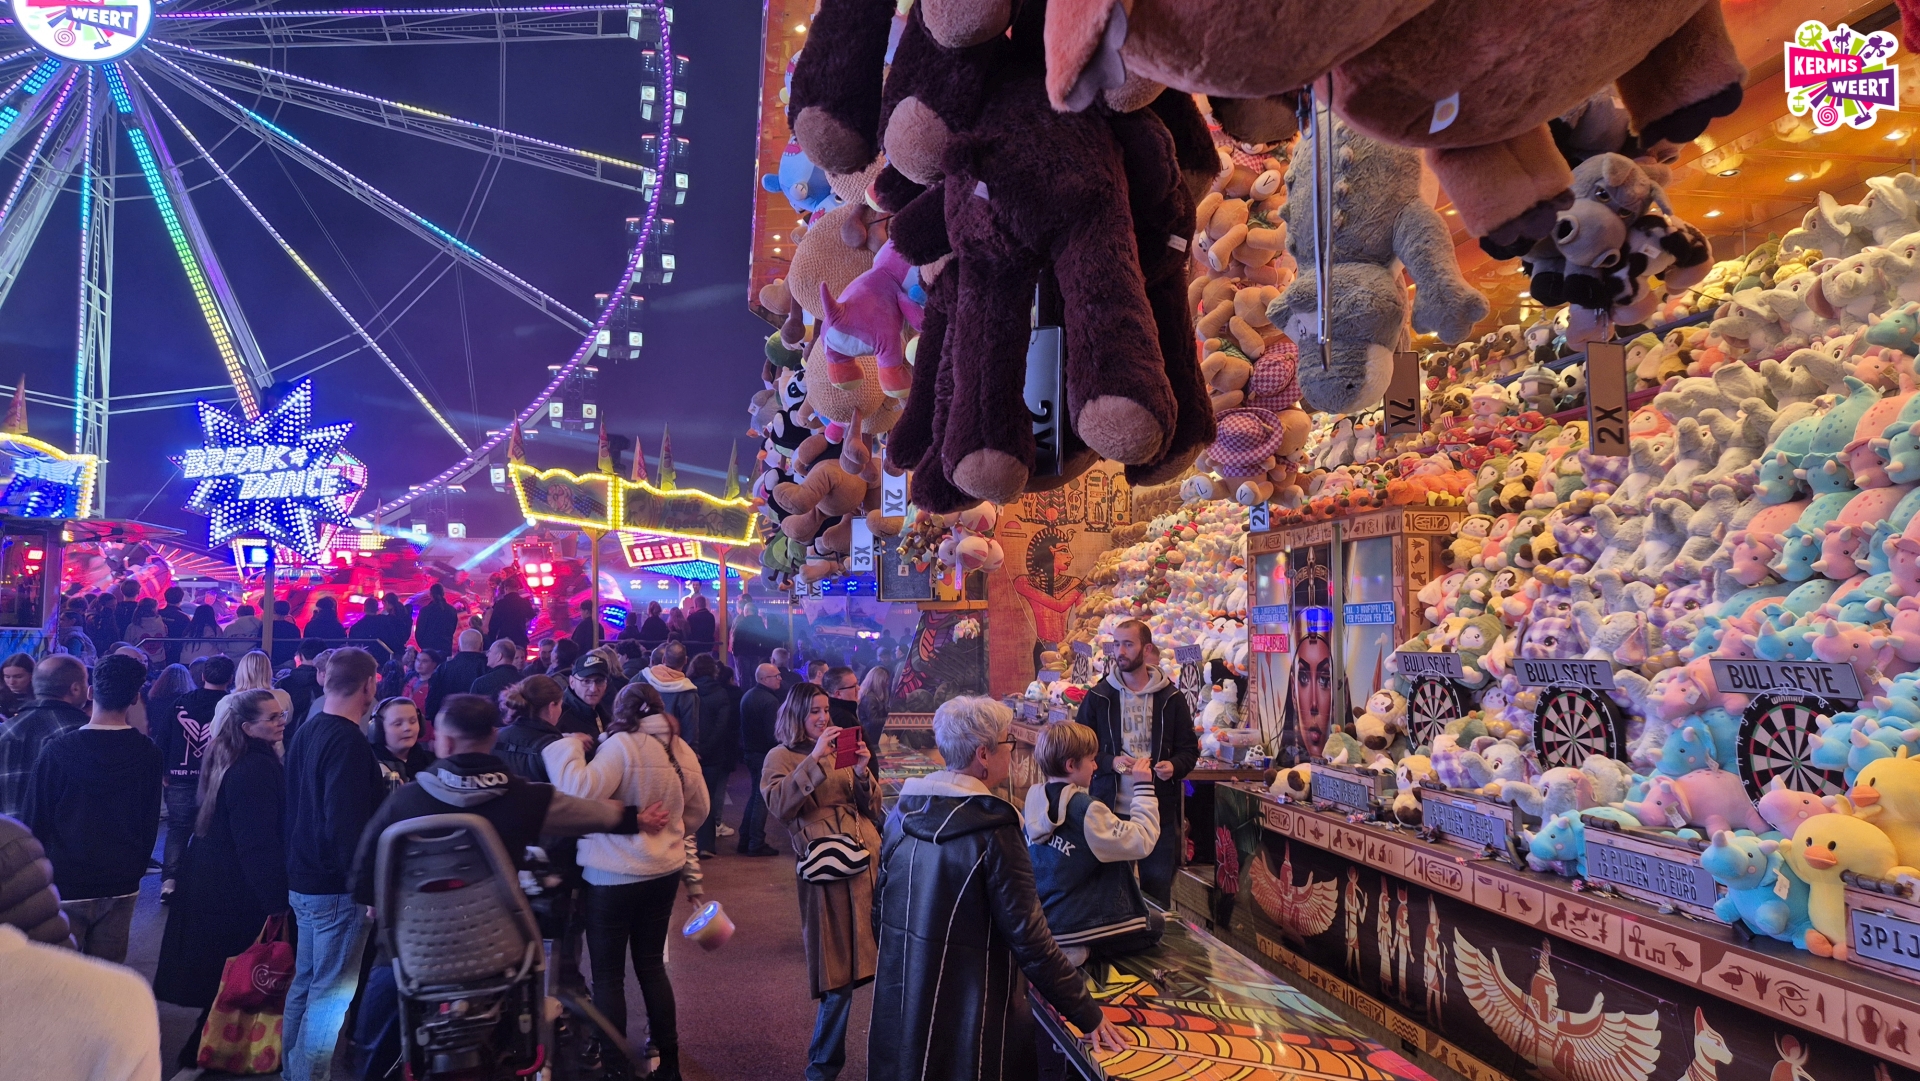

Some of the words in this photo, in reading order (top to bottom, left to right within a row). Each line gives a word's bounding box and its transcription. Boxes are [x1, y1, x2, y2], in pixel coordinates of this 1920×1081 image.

[71, 7, 133, 29] WEERT
[1595, 406, 1625, 445] 2X
[184, 445, 291, 478] BREAK
[238, 467, 341, 499] DANCE
[885, 489, 903, 513] 2X
[854, 545, 870, 565] 3X
[1403, 655, 1454, 674] BULLSEYE
[1525, 663, 1601, 685] BULLSEYE
[1727, 665, 1841, 694] BULLSEYE
[1598, 861, 1609, 877] 12
[1612, 864, 1650, 889] PIJLEN
[1656, 876, 1667, 893] 10
[1670, 879, 1697, 901] EURO
[1611, 850, 1648, 872] PIJLEN
[1668, 863, 1695, 884] EURO
[1860, 922, 1920, 959] 3PIJ
